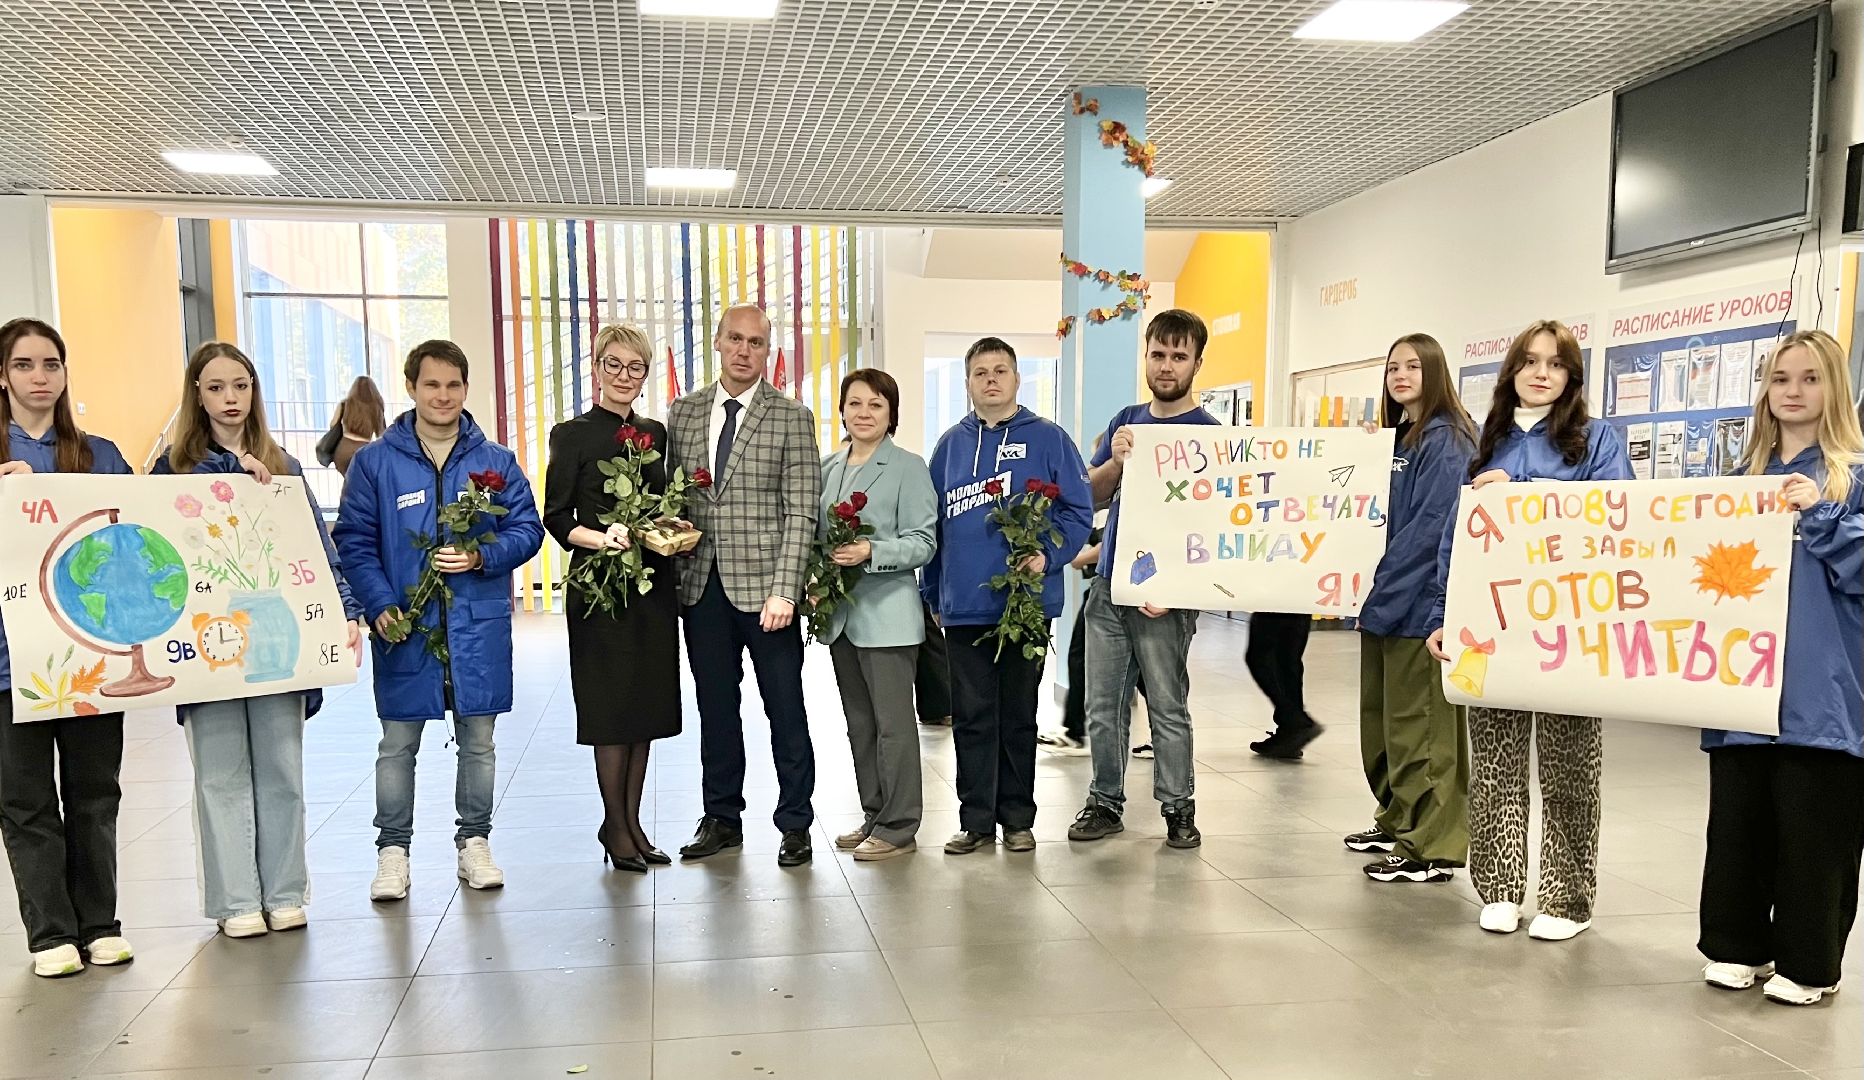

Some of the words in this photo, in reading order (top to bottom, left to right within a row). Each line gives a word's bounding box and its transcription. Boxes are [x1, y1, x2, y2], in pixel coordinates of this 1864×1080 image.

[1319, 278, 1358, 306] ГАРДЕРОБ
[1612, 303, 1715, 337] РАСПИСАНИЕ
[1718, 290, 1792, 321] УРОКОВ
[1154, 438, 1208, 478] РАЗ
[1214, 436, 1288, 466] НИКТО
[1298, 439, 1326, 459] НЕ
[1164, 471, 1277, 503] ХОЧЕТ
[22, 499, 59, 523] 4А
[1230, 494, 1387, 528] ОТВЕЧАТЬ,
[1467, 503, 1505, 554] Я
[1186, 528, 1326, 564] ВЫЙДУ
[1525, 534, 1564, 565] НЕ
[1582, 534, 1676, 560] ЗАБЫЛ
[195, 581, 212, 594] 6А
[288, 560, 315, 586] 3Б
[1489, 569, 1650, 630] ГОТОВ
[167, 640, 196, 663] 9В
[318, 644, 339, 667] 8Е
[1532, 619, 1777, 688] УЧИТЬСЯ
